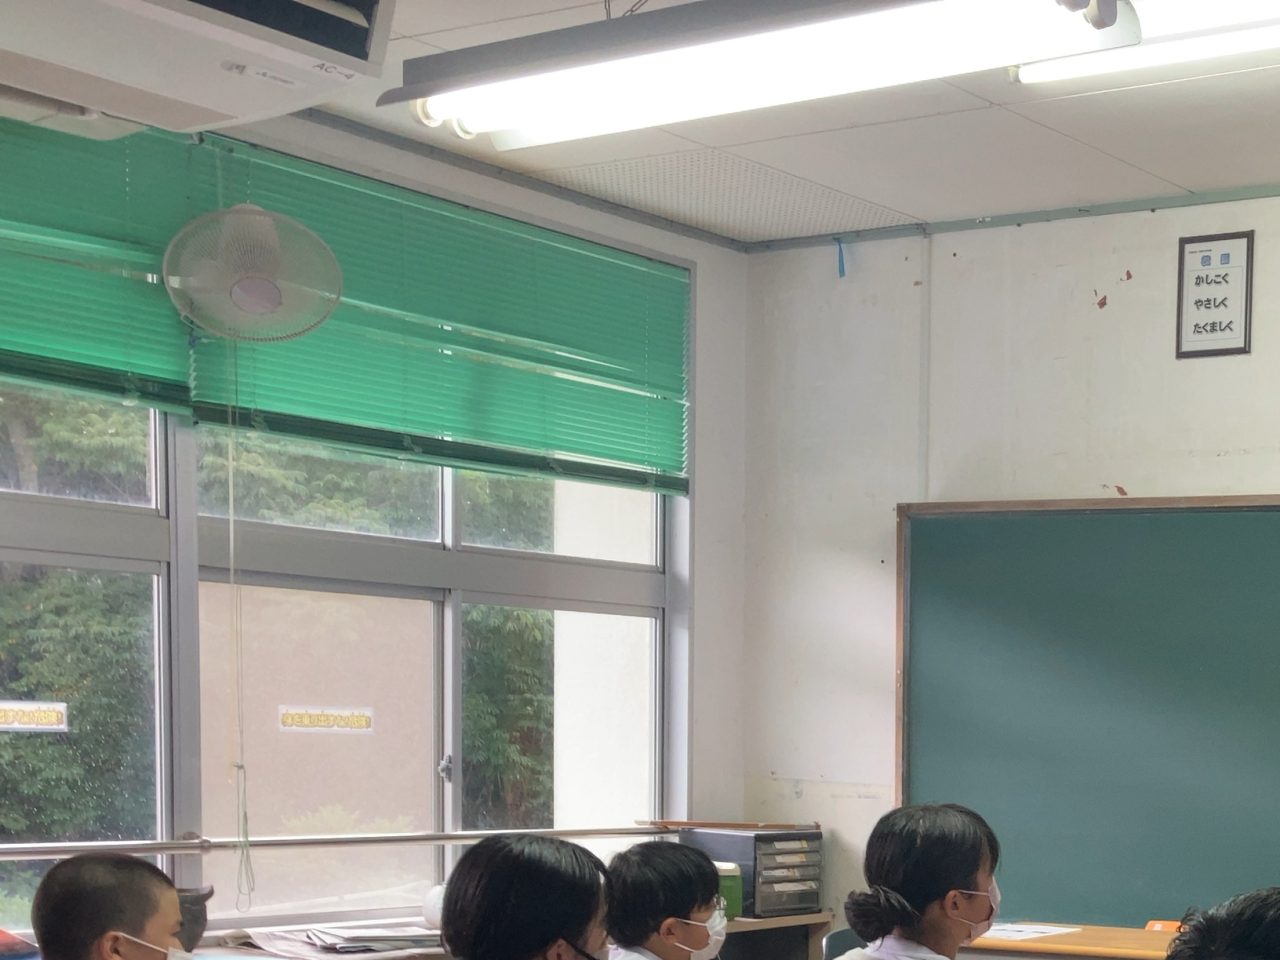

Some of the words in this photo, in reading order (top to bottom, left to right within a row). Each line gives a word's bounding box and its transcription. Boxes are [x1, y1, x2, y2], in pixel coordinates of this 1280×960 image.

[1194, 272, 1229, 286] かしこく
[1194, 297, 1228, 310] やさしく
[1192, 320, 1234, 334] たくましく
